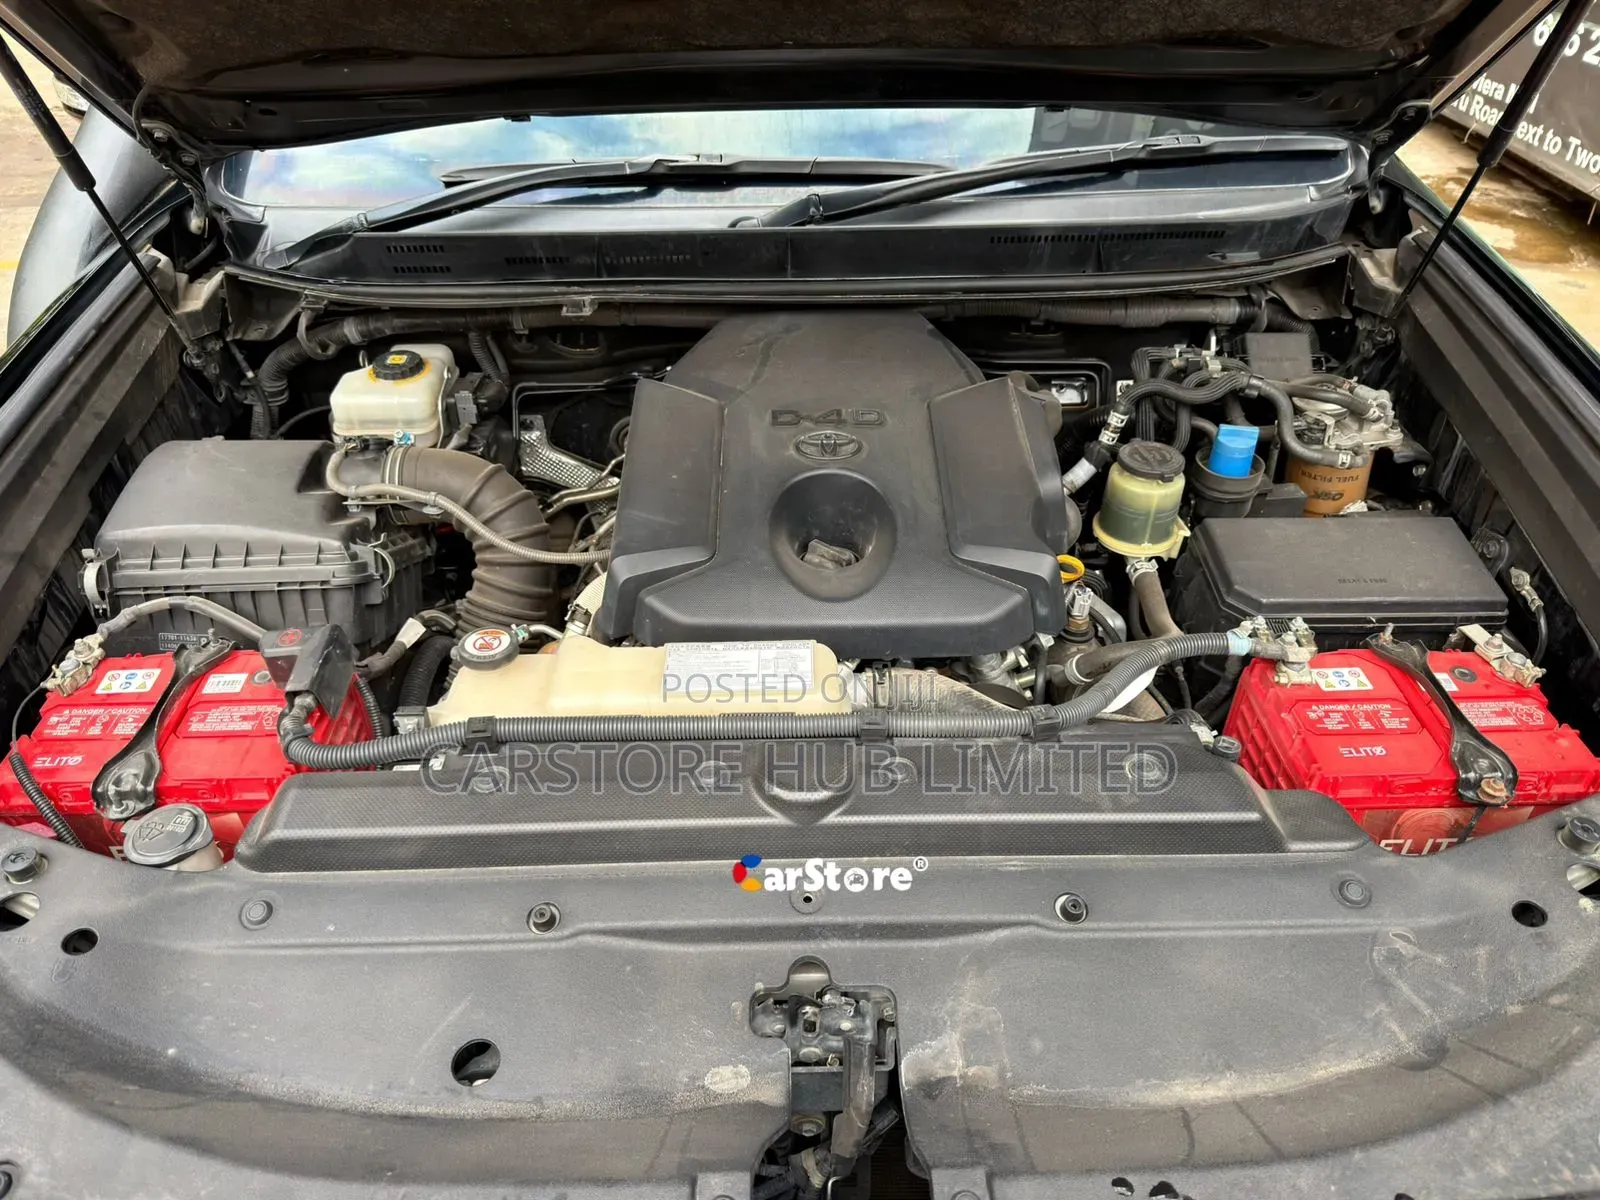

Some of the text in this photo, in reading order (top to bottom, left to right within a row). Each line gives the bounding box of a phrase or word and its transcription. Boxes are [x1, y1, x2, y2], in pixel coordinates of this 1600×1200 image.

[1515, 121, 1545, 147] ext
[1542, 128, 1562, 155] to
[771, 408, 888, 427] D-4D
[1379, 836, 1474, 857] ELIT
